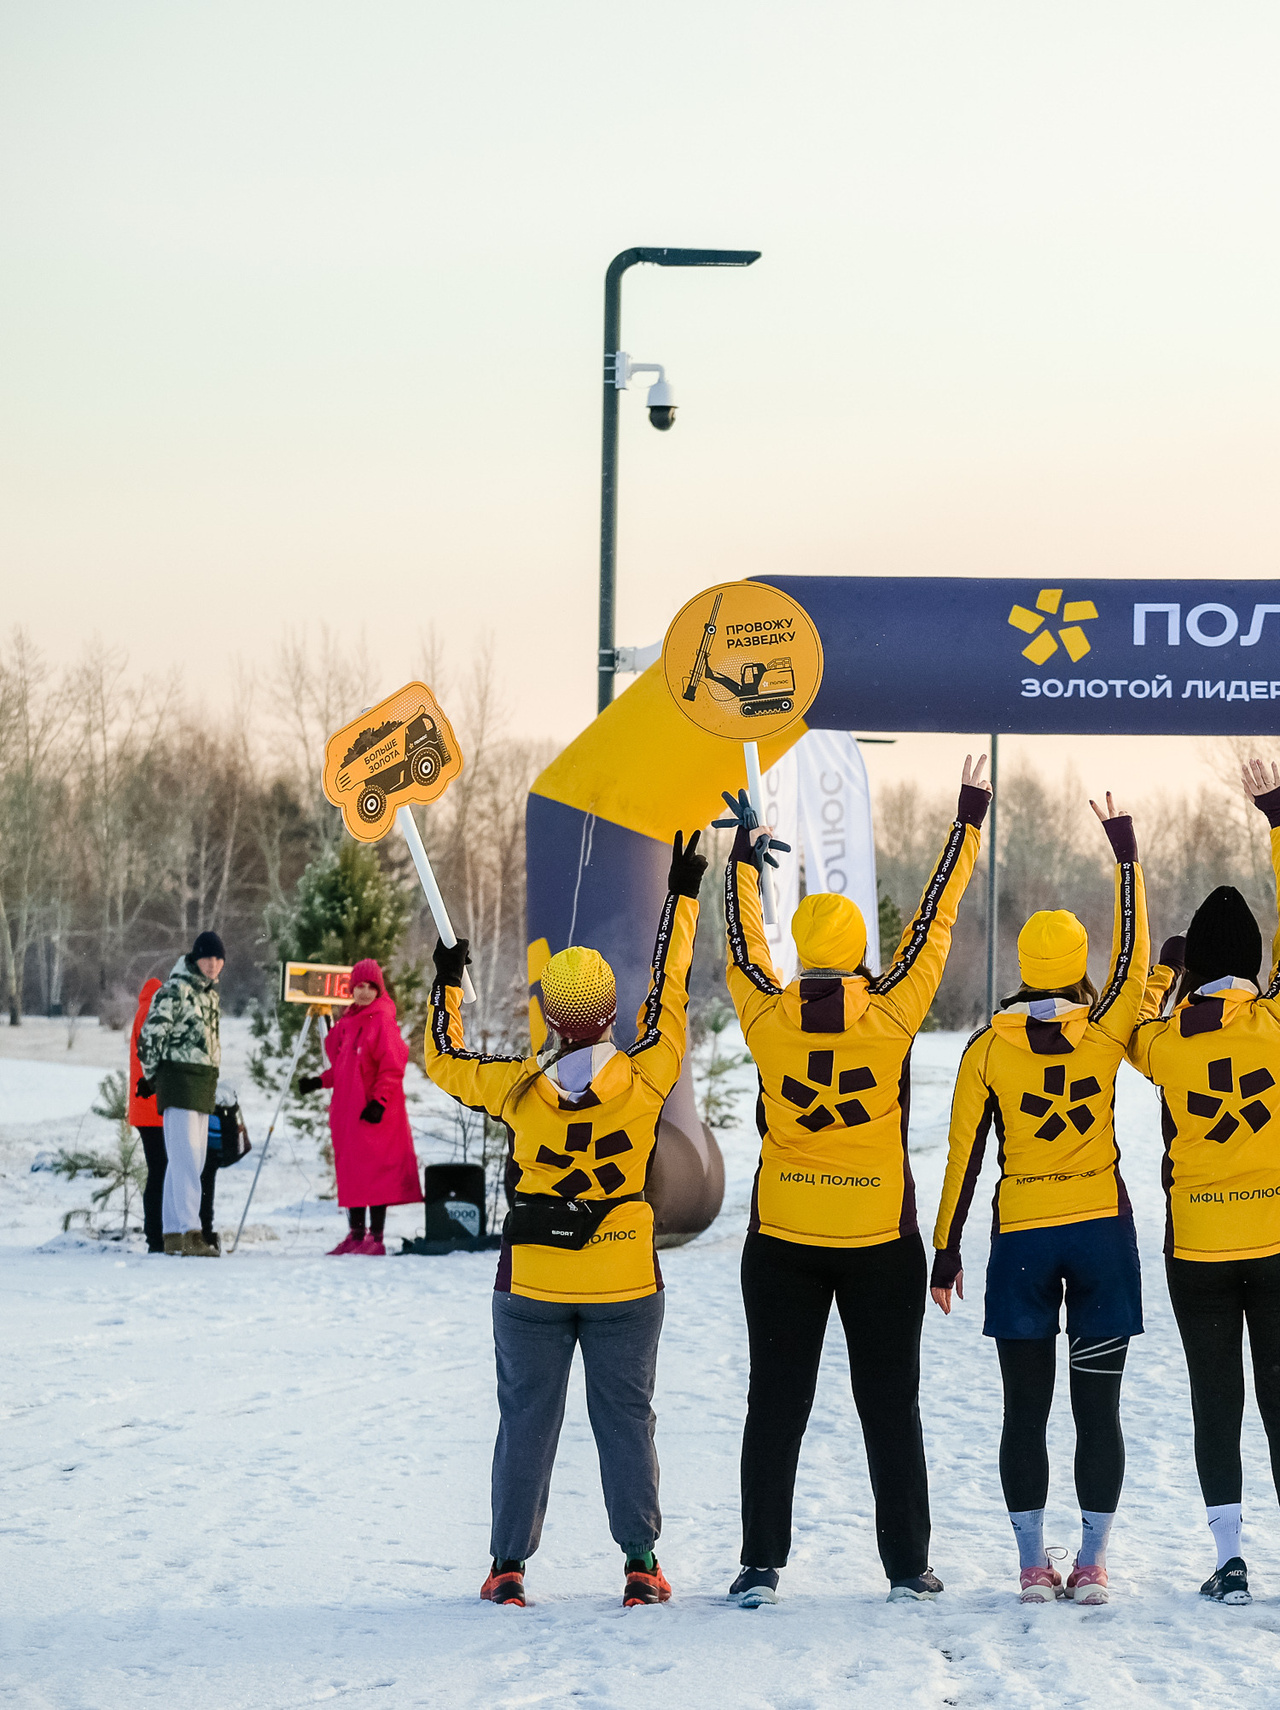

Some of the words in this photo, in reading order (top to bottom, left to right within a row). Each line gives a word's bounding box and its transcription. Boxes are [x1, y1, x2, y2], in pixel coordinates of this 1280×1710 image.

[726, 618, 794, 635] ПРОВОЖУ
[727, 631, 796, 649] РАЗВЕДКУ
[1020, 674, 1173, 698] ЗОЛОТОЙ
[364, 738, 398, 765] БОЛЬШЕ
[369, 750, 400, 773] ЗОЛОТА
[779, 1172, 815, 1185] МФЦ
[820, 1174, 881, 1187] ПОЛЮС
[1190, 1193, 1224, 1204] МФЦ
[587, 1230, 636, 1245] ОЛЮС
